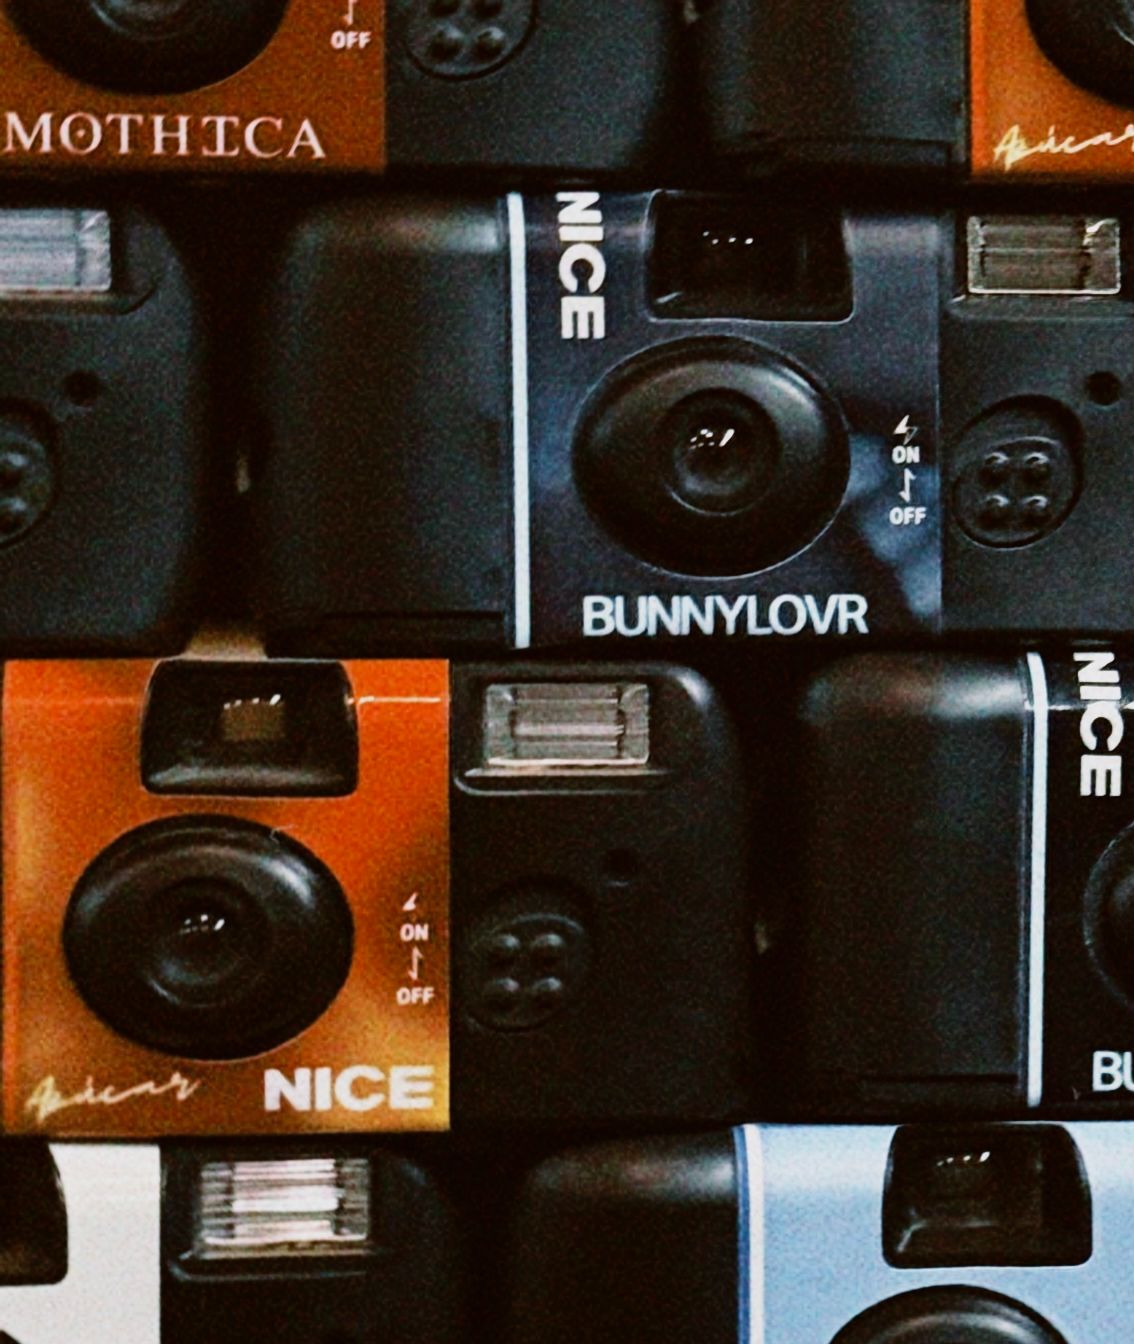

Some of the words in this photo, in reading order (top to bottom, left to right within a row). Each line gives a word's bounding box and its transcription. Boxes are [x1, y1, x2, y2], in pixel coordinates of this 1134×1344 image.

[330, 30, 371, 49] OFF
[6, 112, 325, 158] MOTHICA
[557, 192, 605, 338] NICE
[891, 445, 920, 464] ON
[889, 506, 927, 525] OFF
[583, 594, 868, 636] BUNNYLOVR
[1073, 652, 1125, 797] NICE
[399, 923, 429, 942] ON
[396, 986, 434, 1006] OFF
[264, 1065, 434, 1112] NICE
